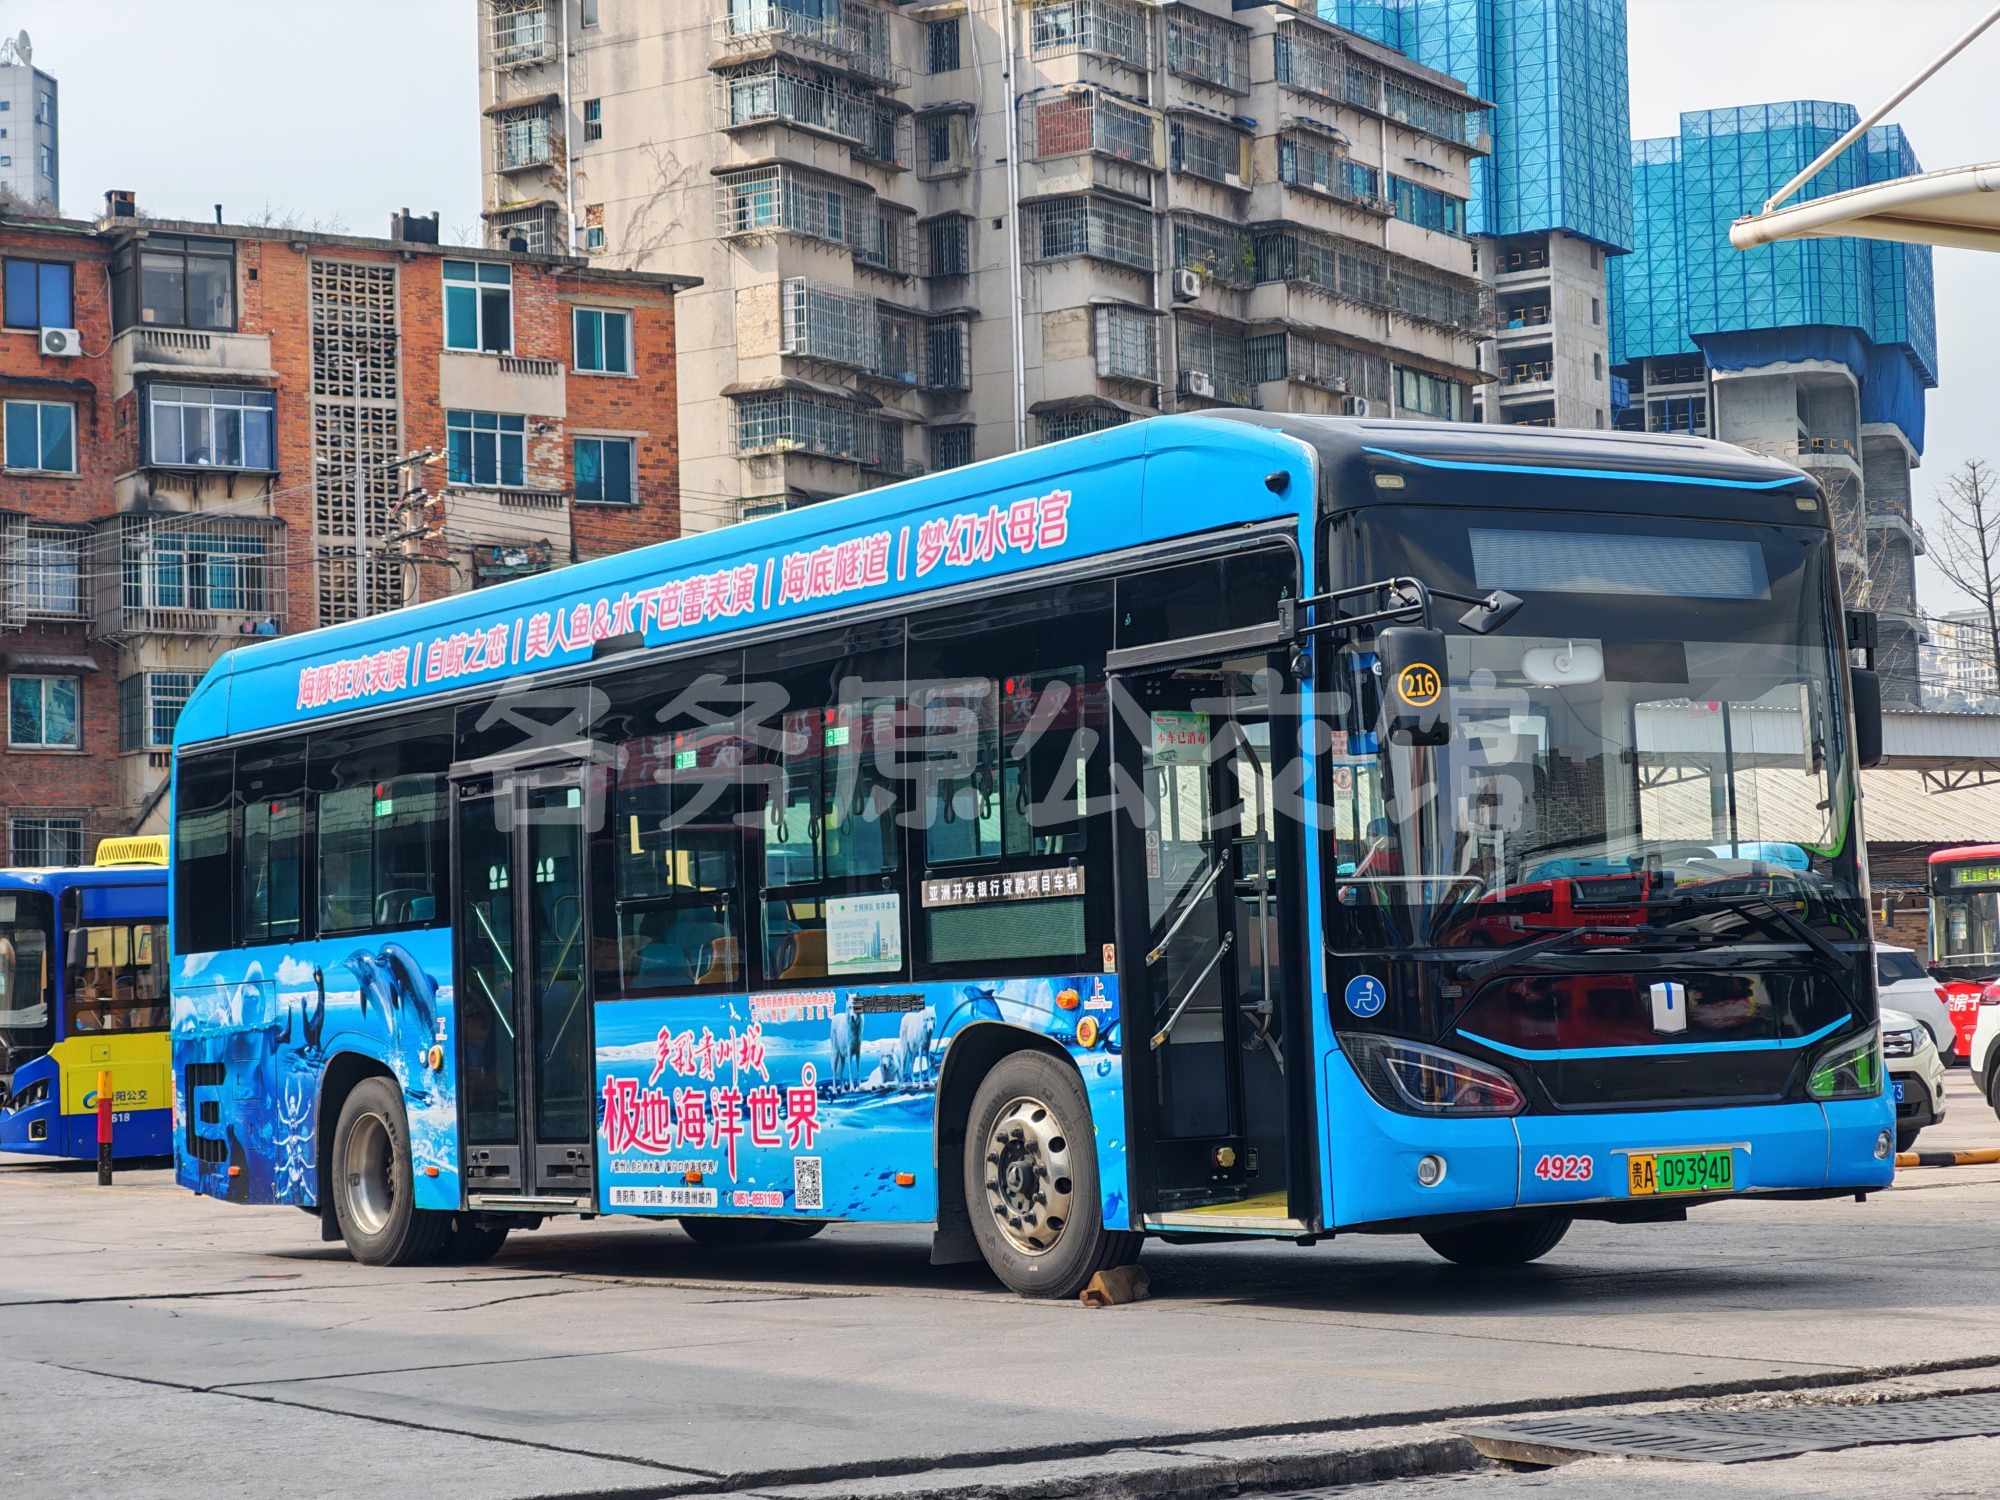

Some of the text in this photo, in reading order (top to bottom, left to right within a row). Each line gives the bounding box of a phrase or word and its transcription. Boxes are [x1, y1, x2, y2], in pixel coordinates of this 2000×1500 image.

[1405, 673, 1435, 697] 216
[928, 872, 1078, 901] 亚洲开发银行贷款项目车辆
[1091, 977, 1105, 1001] 上
[112, 1090, 147, 1101] 阳公交
[603, 1062, 821, 1183] 极地海洋世界
[1535, 1154, 1594, 1181] 4923
